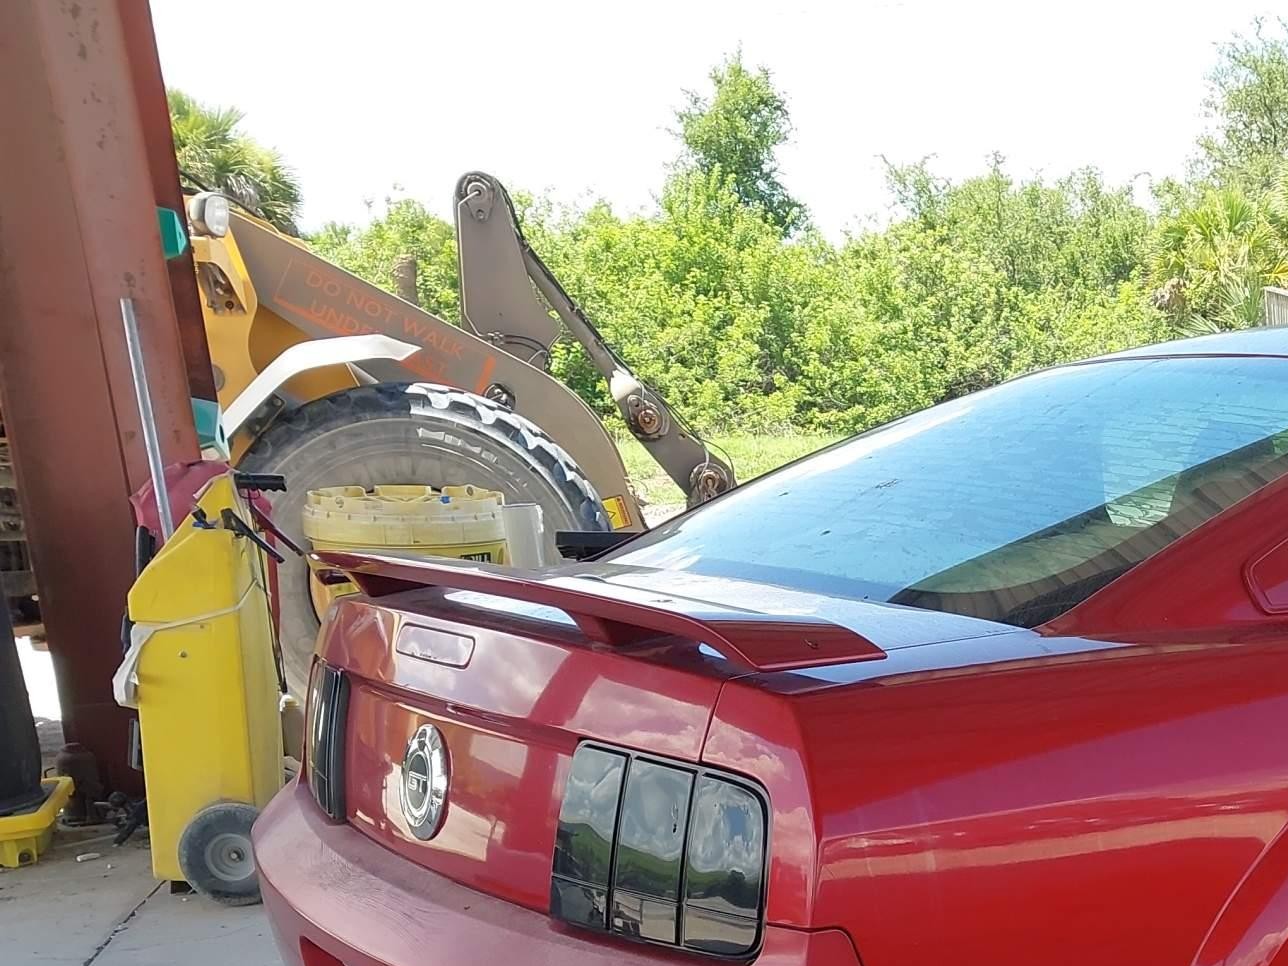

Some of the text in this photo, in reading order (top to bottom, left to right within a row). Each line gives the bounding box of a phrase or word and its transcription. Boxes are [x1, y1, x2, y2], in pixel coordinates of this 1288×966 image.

[306, 272, 463, 360] DO NOT WALK
[408, 771, 427, 792] GT
